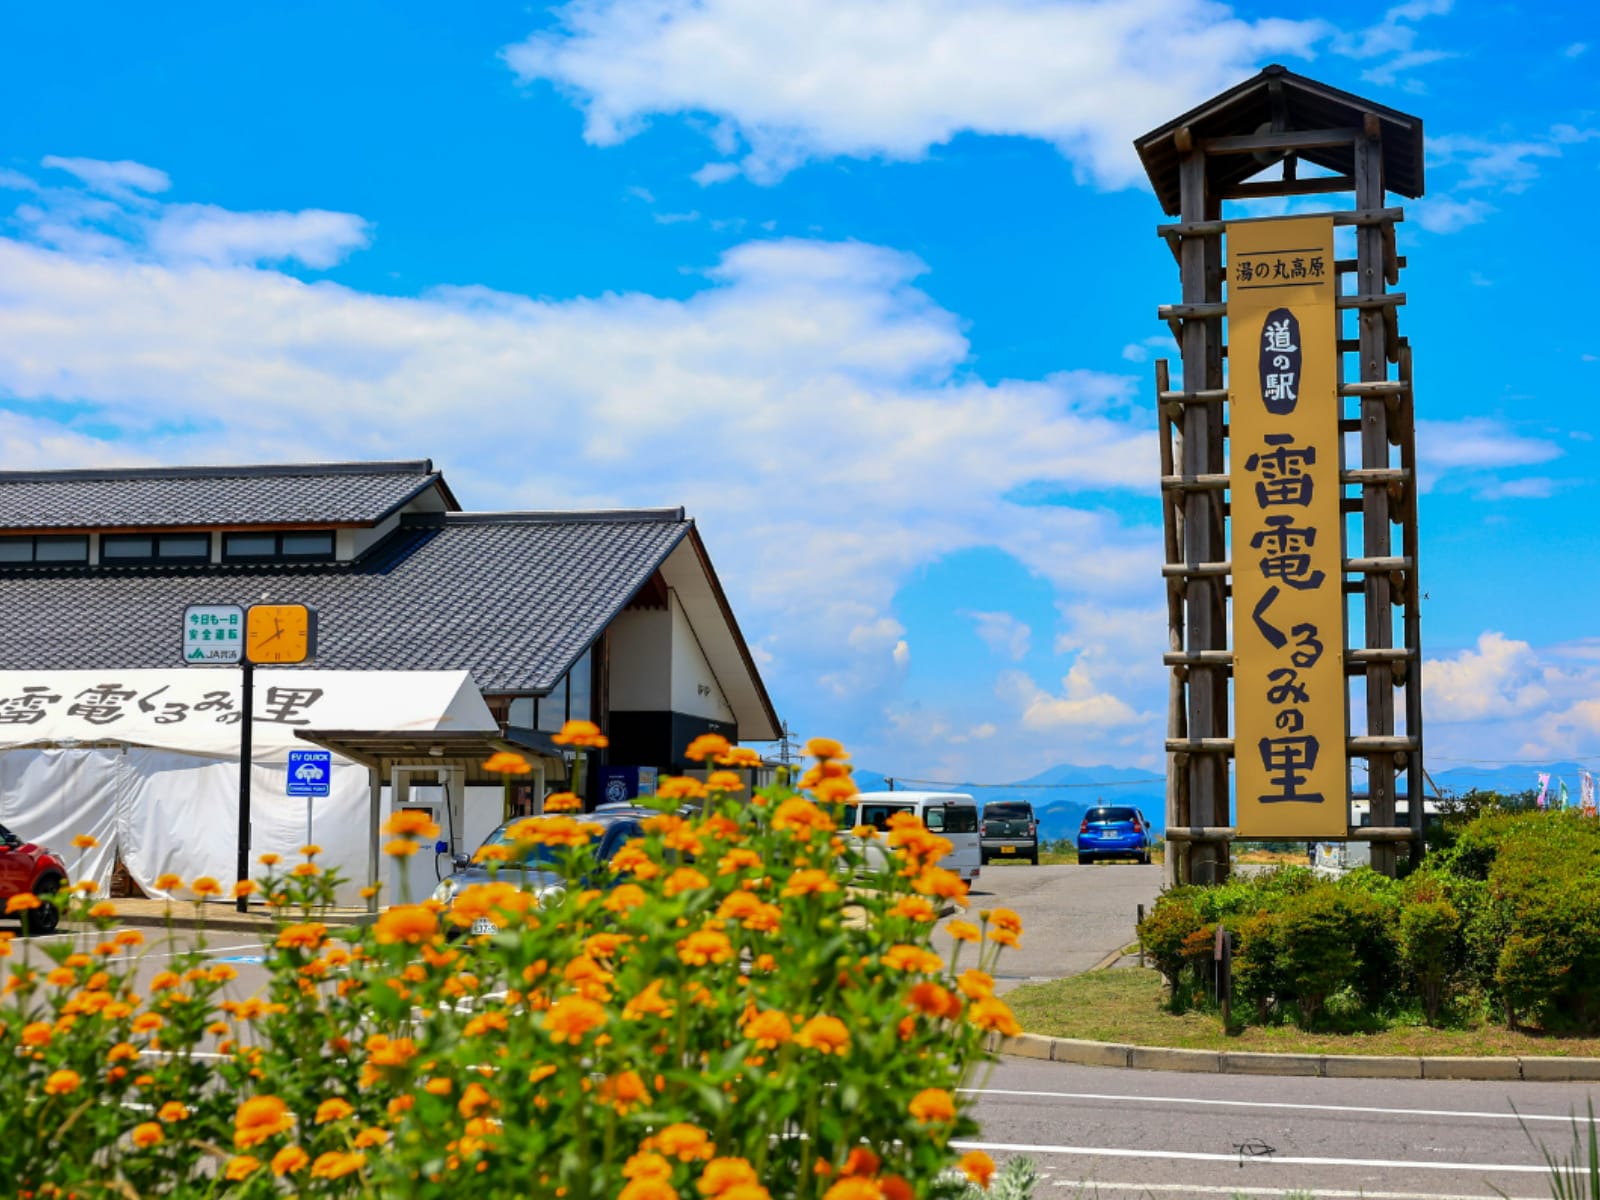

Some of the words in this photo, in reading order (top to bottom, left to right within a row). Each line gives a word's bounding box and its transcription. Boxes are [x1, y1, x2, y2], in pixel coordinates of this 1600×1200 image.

[1236, 256, 1325, 281] 湯の丸高原
[1264, 318, 1299, 401] 道の駅
[190, 613, 238, 625] 今日も一日
[1244, 433, 1326, 804] 雷電くるみの里
[189, 628, 238, 640] 安全運転
[291, 753, 302, 761] EV
[303, 753, 329, 761] QUICK
